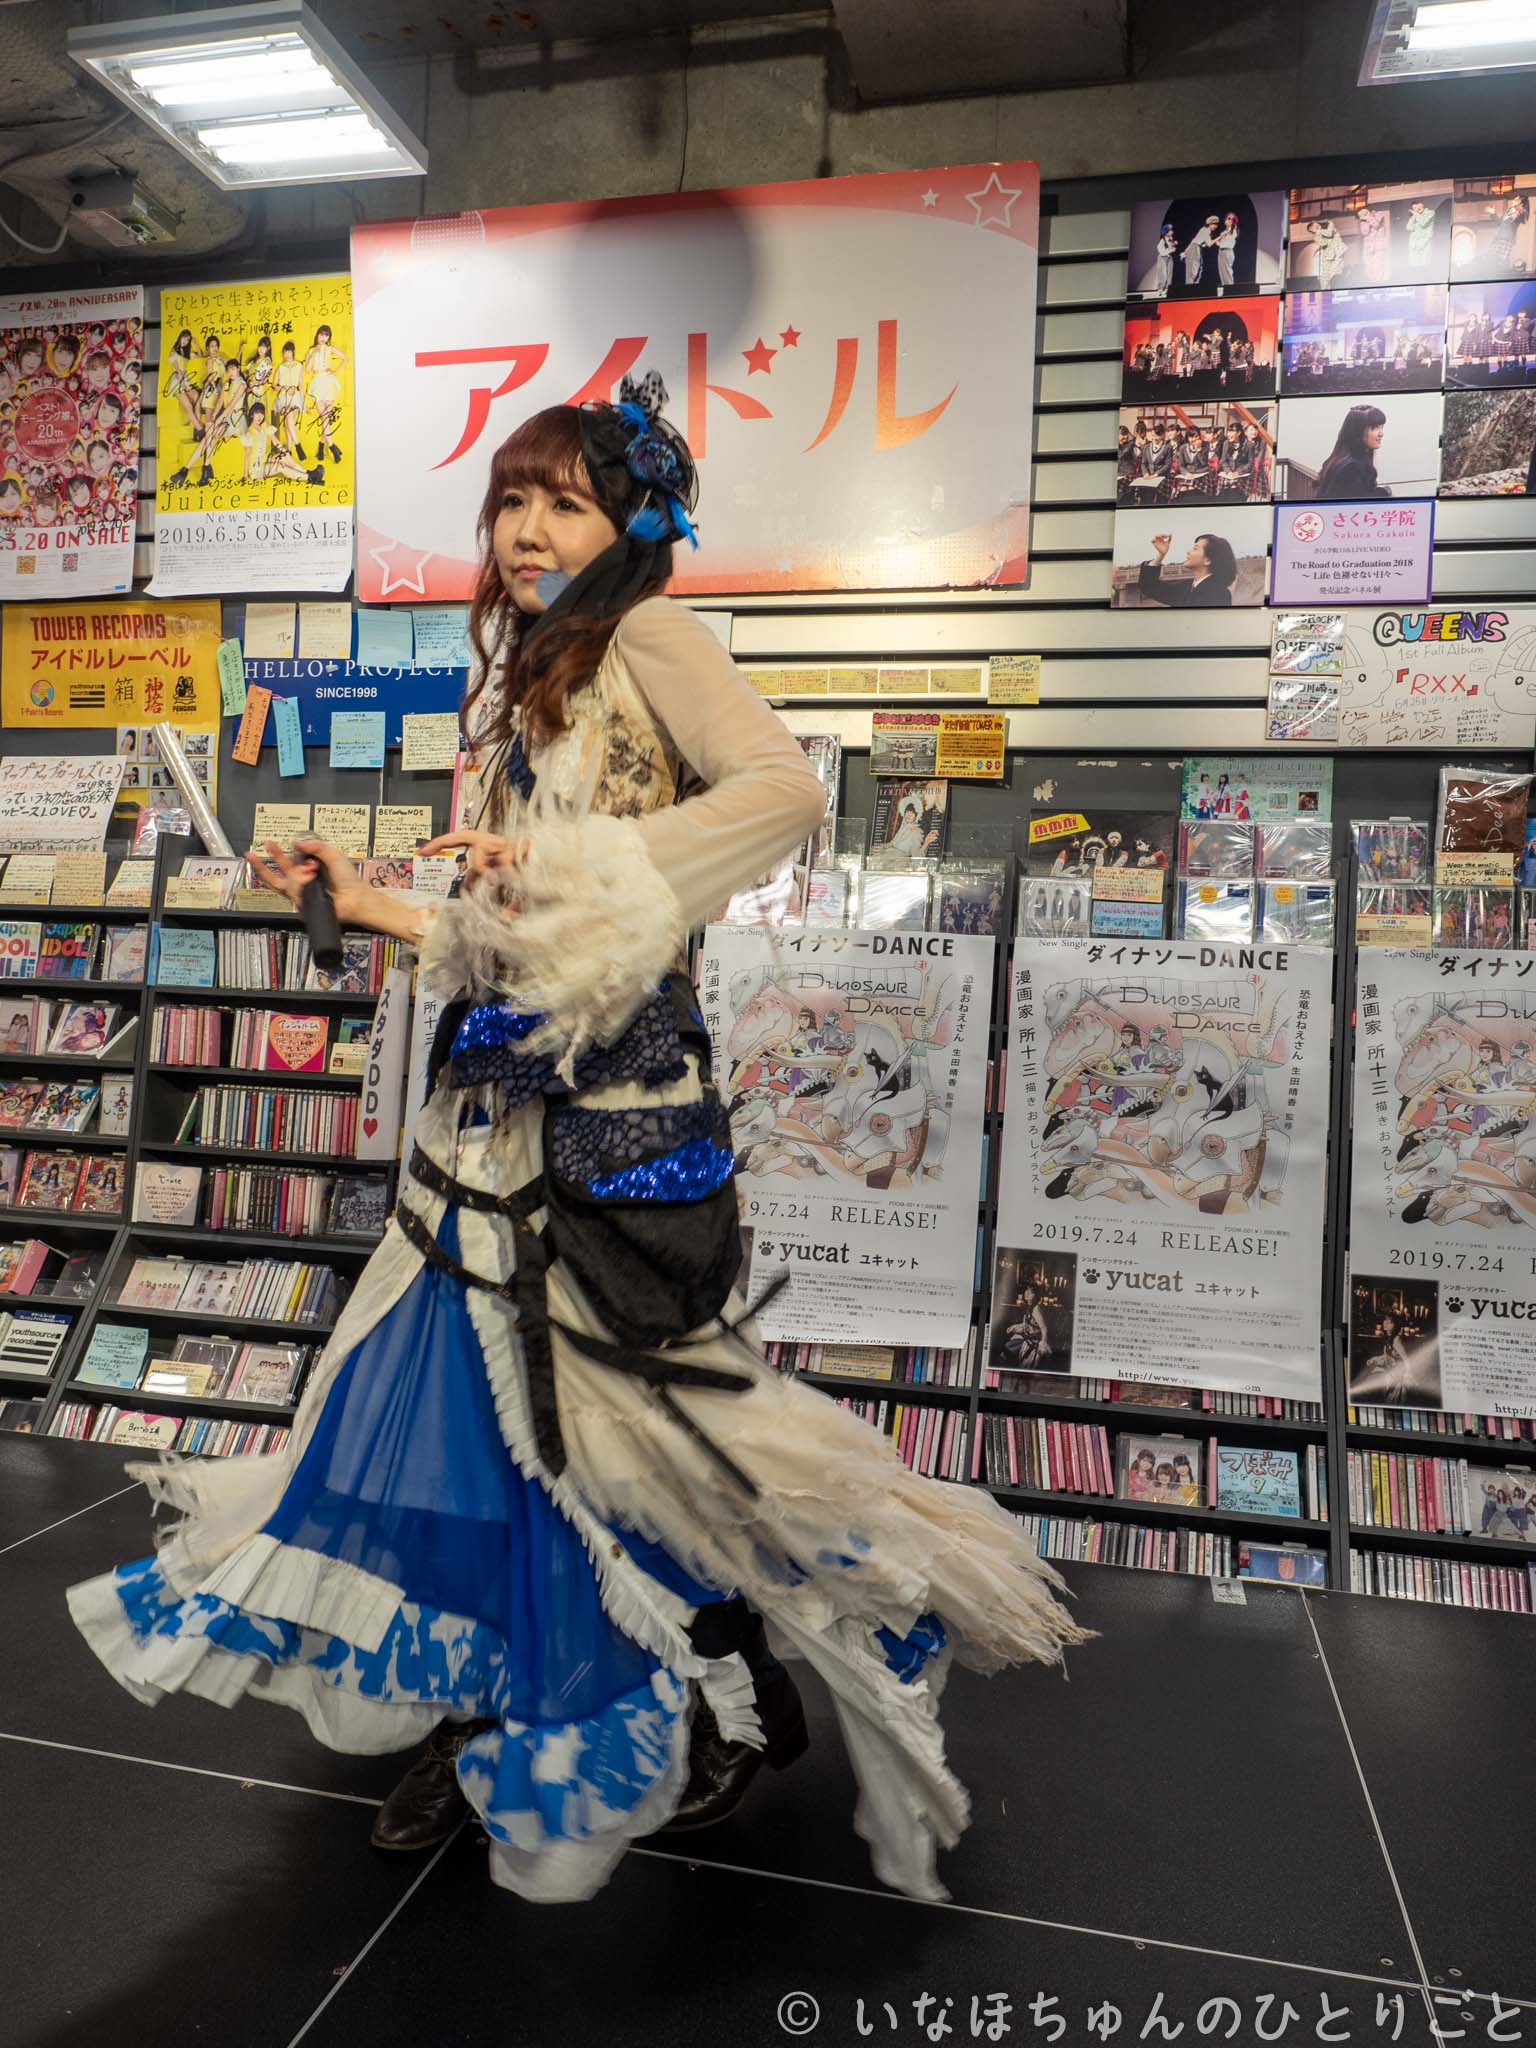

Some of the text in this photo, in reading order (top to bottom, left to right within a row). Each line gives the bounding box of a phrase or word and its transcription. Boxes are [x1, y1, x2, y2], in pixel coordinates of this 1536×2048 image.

[69, 290, 138, 306] ANNIVERSARY
[161, 485, 348, 512] Juice=Juice
[205, 510, 299, 525] New Single
[1333, 510, 1416, 528] さくら学院
[56, 529, 80, 549] ON
[88, 525, 131, 546] SALE
[160, 521, 348, 545] 2019.6.5 ON SALE
[1333, 529, 1415, 540] Sakura Gakuin
[1290, 559, 1414, 570] The Road to Graduation 2018
[1313, 571, 1331, 580] Life
[31, 613, 167, 642] TOWER RECORDS
[1373, 611, 1509, 647] QUEENS
[31, 646, 192, 671] アイドルレーベル
[1398, 643, 1485, 661] 1st Full Album
[115, 677, 136, 701] 箱
[315, 686, 378, 699] SINCE1998
[46, 922, 92, 938] Japan
[772, 934, 955, 958] ダイナソーDANCE
[1038, 938, 1088, 949] New Single
[1409, 949, 1440, 962] Single
[1087, 944, 1289, 971] ダイナソーDANCE
[705, 958, 720, 1004] 漫画家
[797, 971, 908, 996] DINOSAUR
[844, 995, 927, 1018] DANCE
[1119, 985, 1241, 1009] DINOSAUR
[1171, 1011, 1262, 1034] DANCE
[1291, 989, 1312, 1061] 恐竜おねえさん
[705, 1011, 722, 1059] 所十三
[1016, 969, 1040, 1195] 漫画家 所十三 描きおろしイラスト
[1287, 1067, 1301, 1107] 生田晴香
[1361, 983, 1396, 1219] 漫画家 所十三 描きおろしイラスト
[830, 1204, 938, 1230] RELEASE!
[1032, 1222, 1138, 1247] 2019.7.24
[1160, 1230, 1279, 1257] RELEASE!
[779, 1241, 920, 1270] yucat ユキャット
[1080, 1255, 1140, 1267] シンガーソングライター
[1389, 1248, 1505, 1273] 2019.7.24
[1105, 1268, 1260, 1299] yucat ユキャット
[1443, 1283, 1507, 1294] シンガーソングライター
[1219, 1450, 1294, 1481] つぼみ
